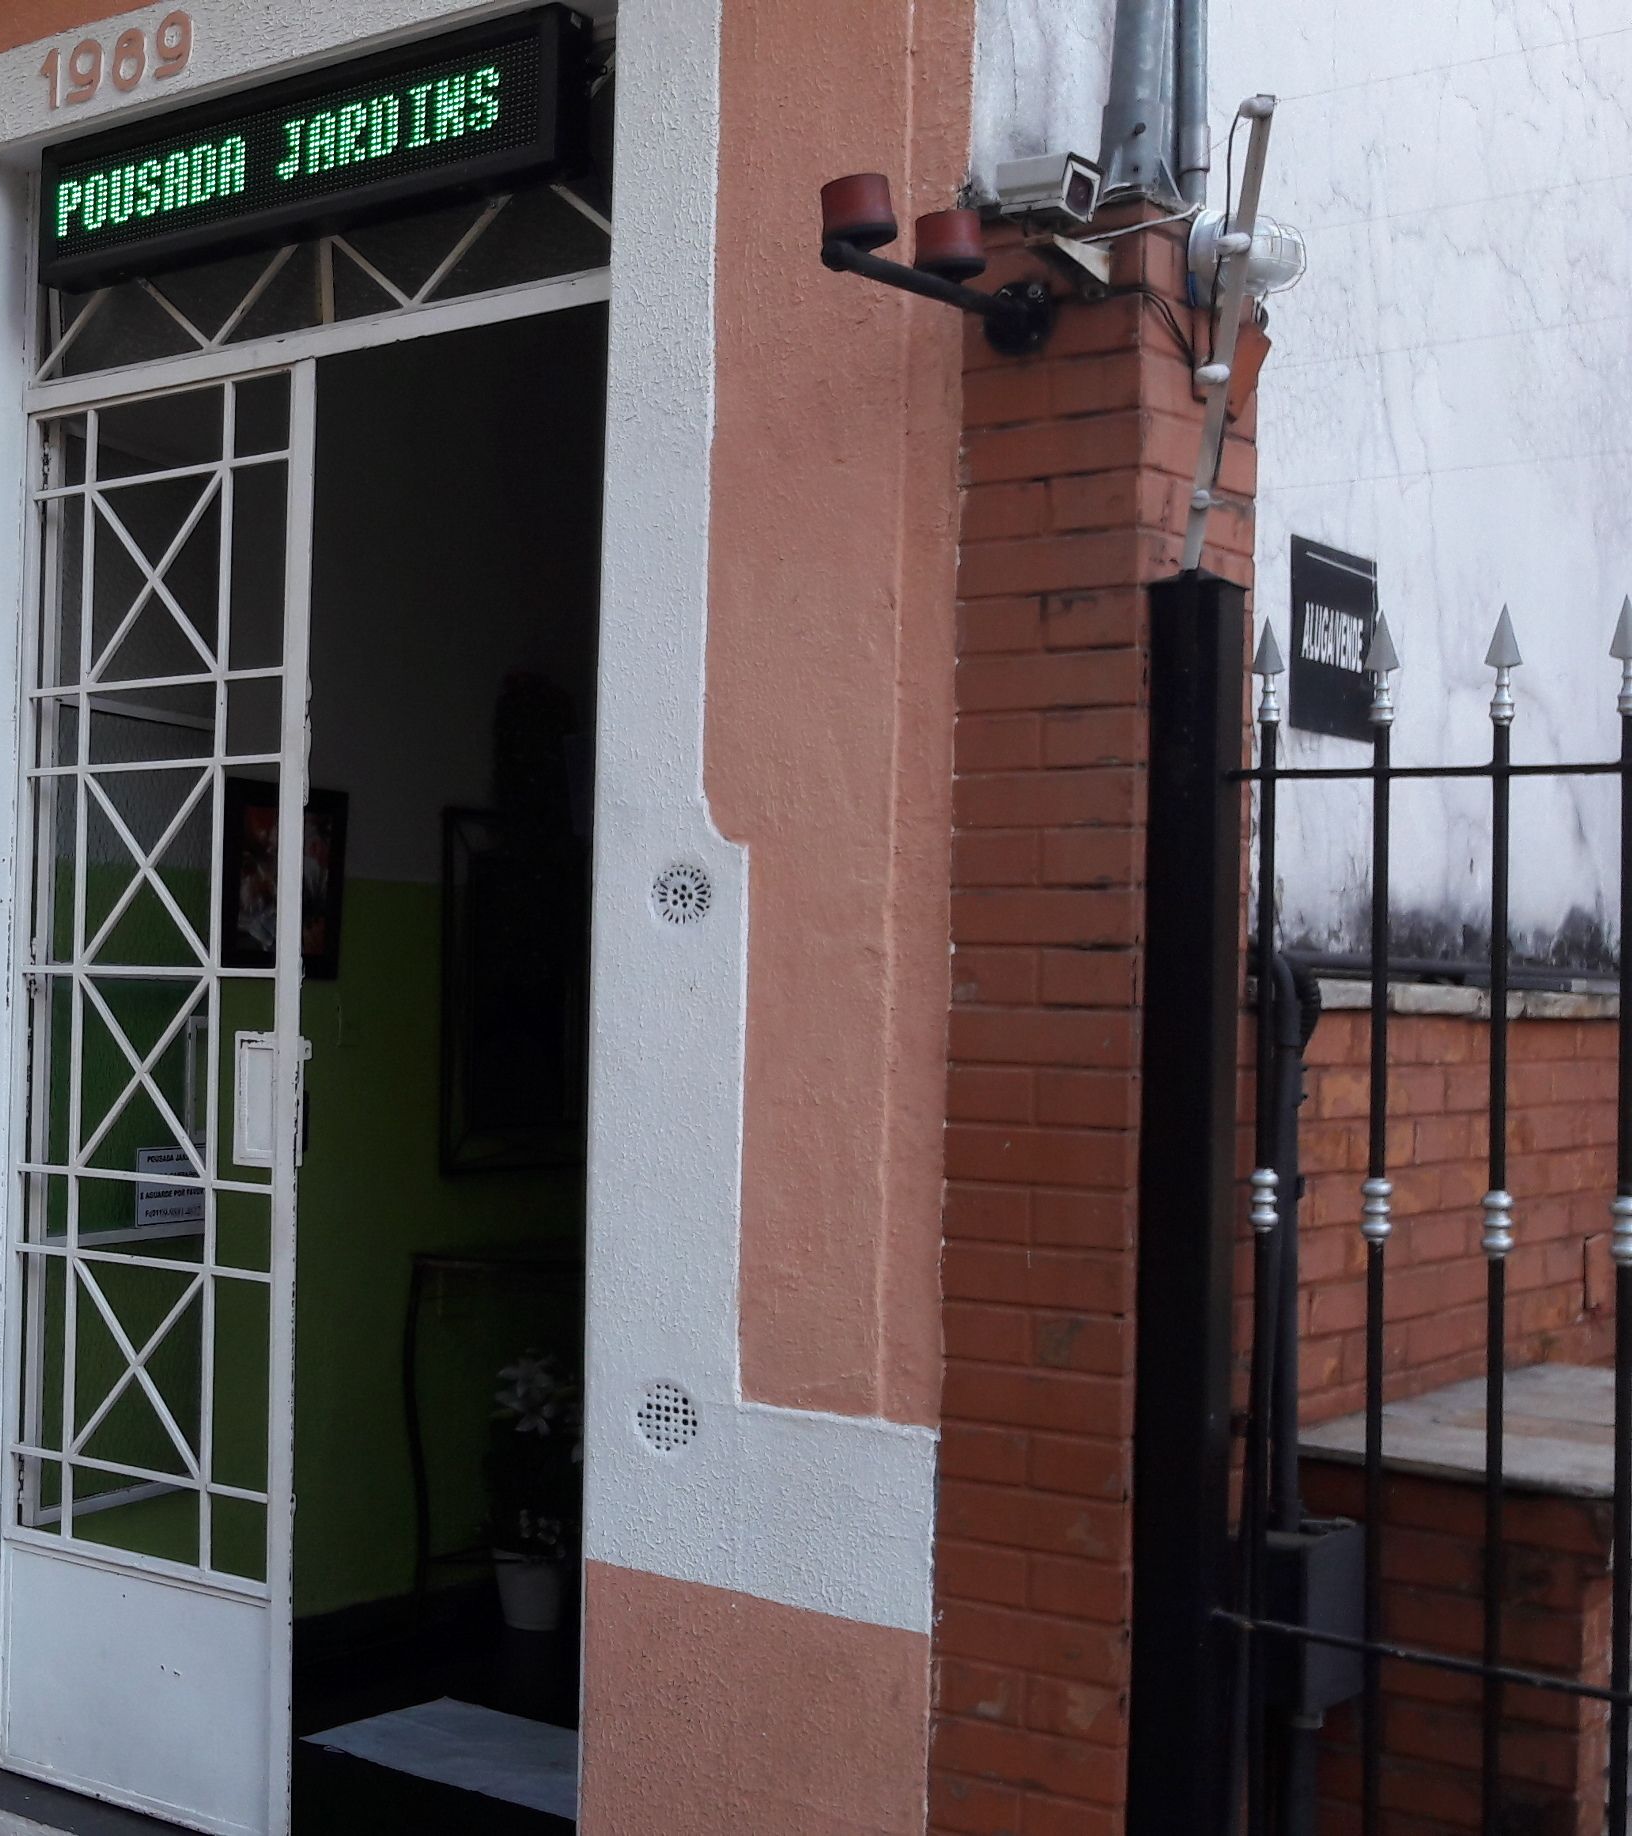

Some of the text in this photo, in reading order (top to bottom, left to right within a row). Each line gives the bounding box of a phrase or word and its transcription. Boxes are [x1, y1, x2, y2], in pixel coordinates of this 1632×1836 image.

[40, 11, 195, 110] 1989
[56, 65, 501, 238] POUSADA JARDINS
